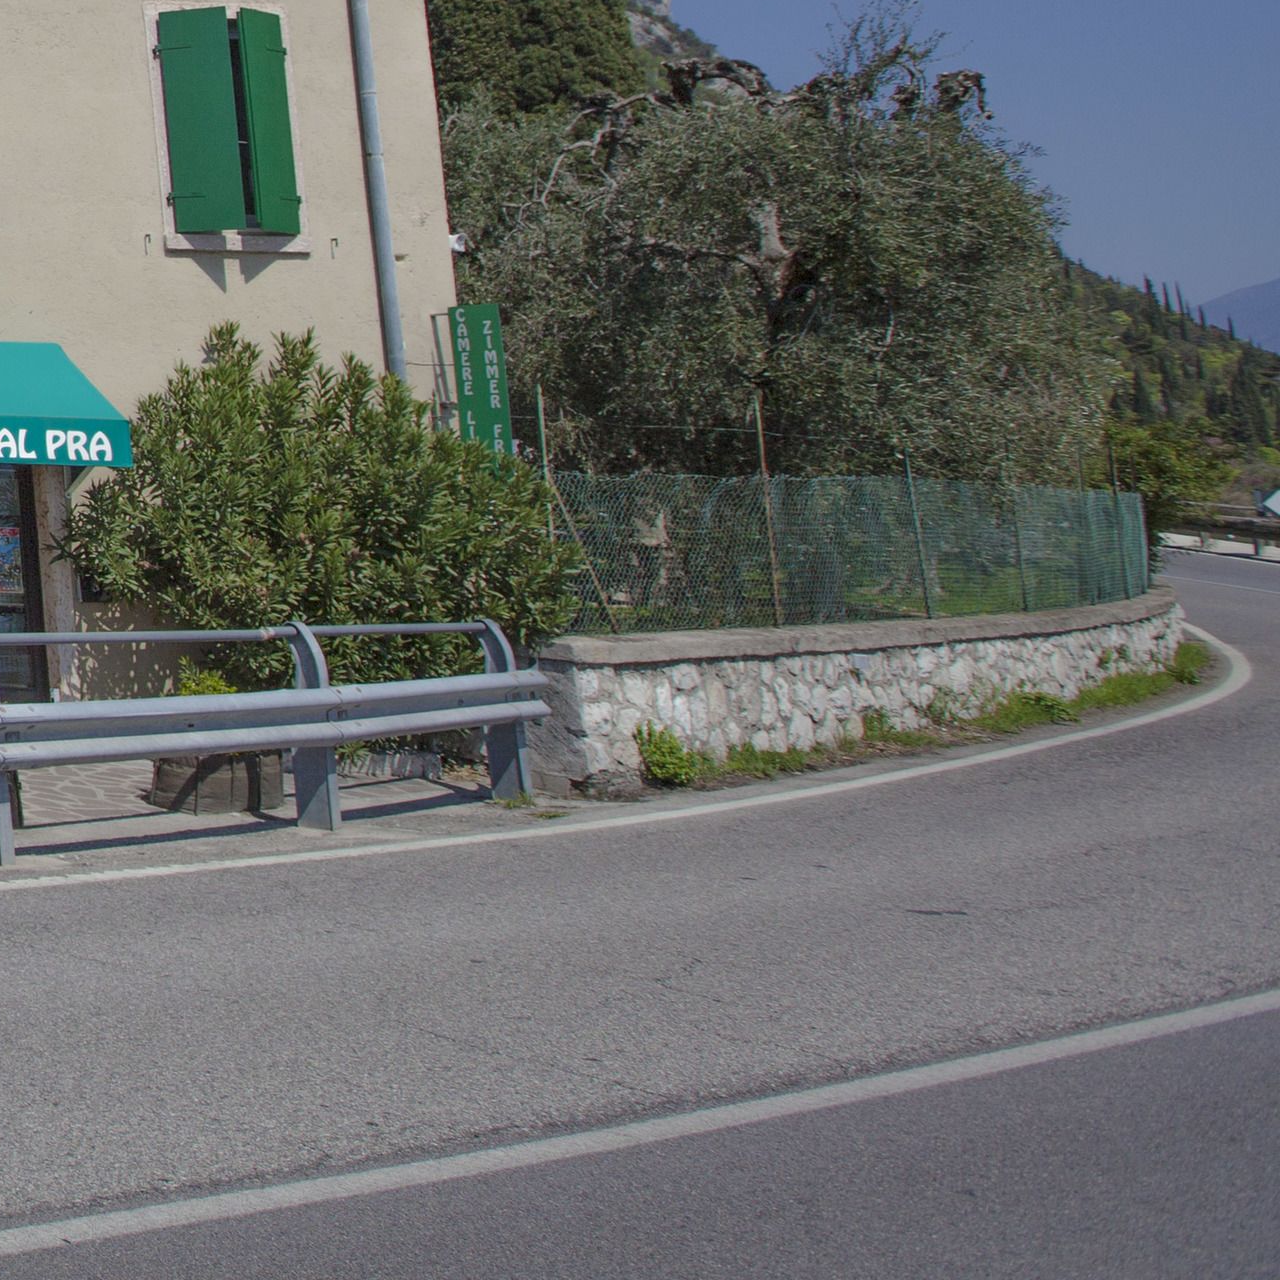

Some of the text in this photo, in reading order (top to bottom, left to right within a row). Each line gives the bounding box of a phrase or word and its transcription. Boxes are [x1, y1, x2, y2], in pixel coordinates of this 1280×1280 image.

[455, 308, 477, 440] CAMERE LI
[482, 320, 505, 456] ZIMMER FR
[44, 429, 114, 462] PRA
